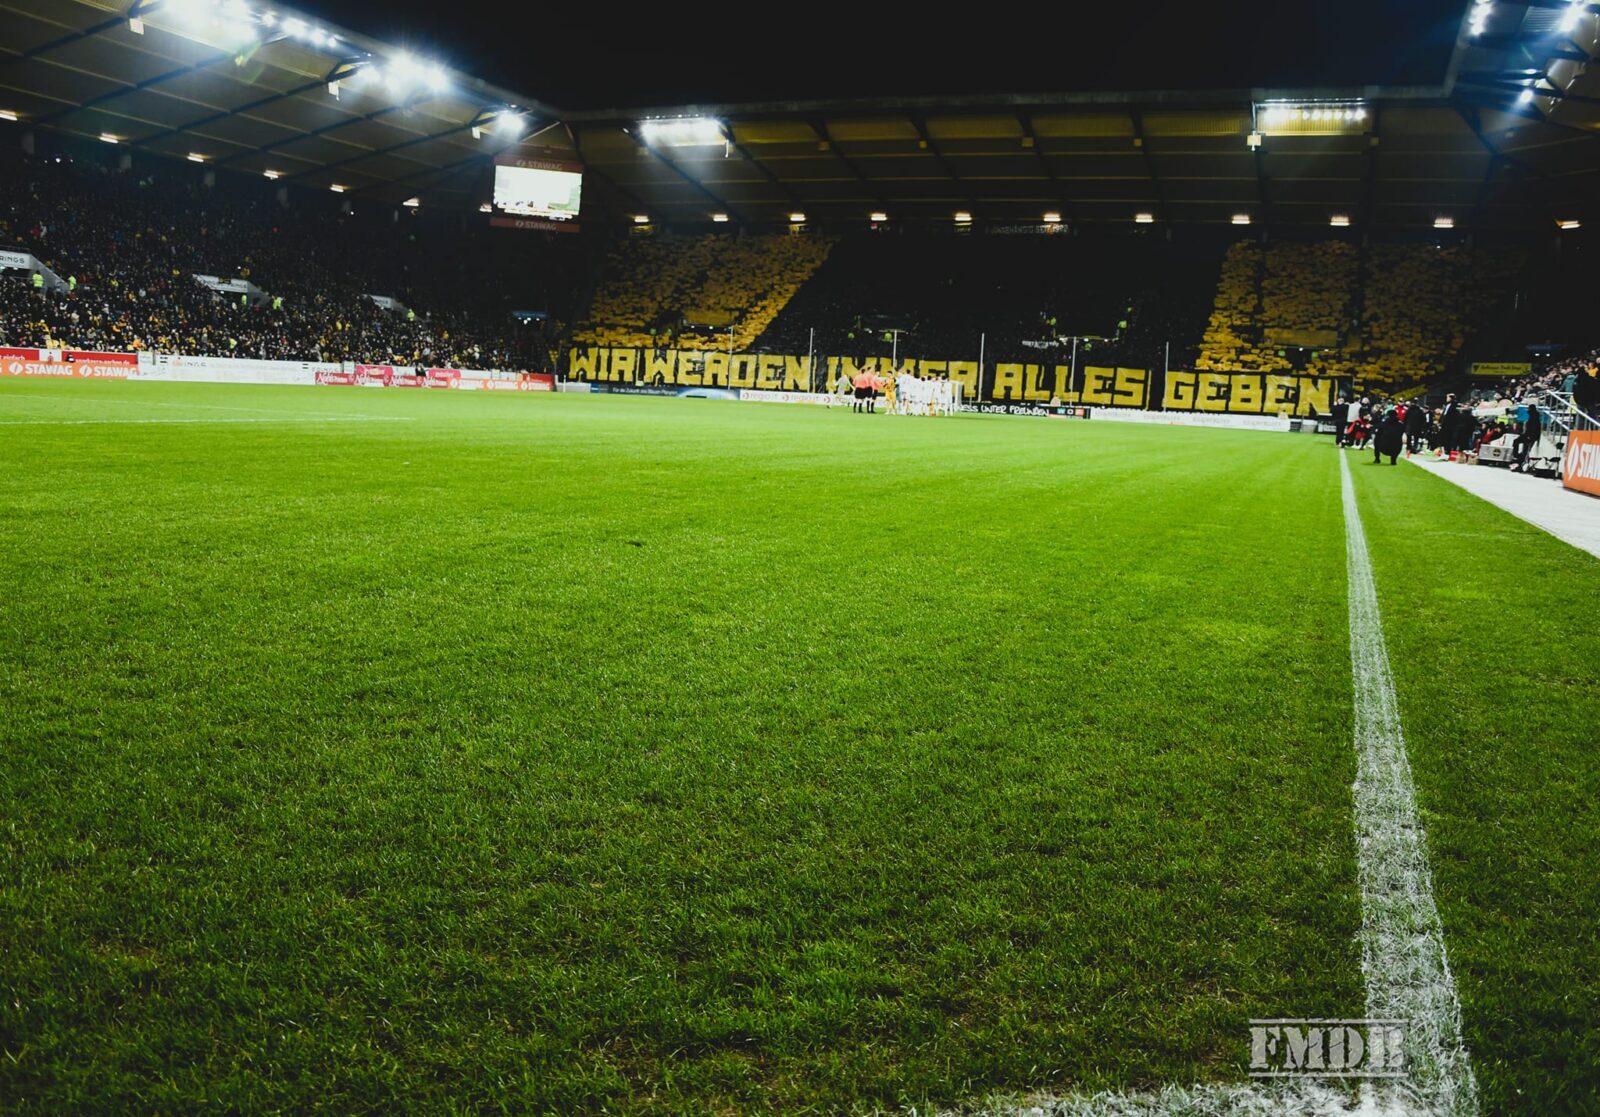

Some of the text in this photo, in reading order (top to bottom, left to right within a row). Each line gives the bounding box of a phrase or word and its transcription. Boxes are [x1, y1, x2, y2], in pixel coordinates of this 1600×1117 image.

[527, 160, 563, 171] STAWAG
[525, 221, 557, 230] STAWAG
[25, 363, 73, 375] STAWAG
[94, 365, 138, 378] STAWAG
[568, 346, 636, 382] WIR
[992, 362, 1146, 406] ALLES
[1163, 370, 1332, 416] GEBEN
[981, 404, 1007, 414] UNTER
